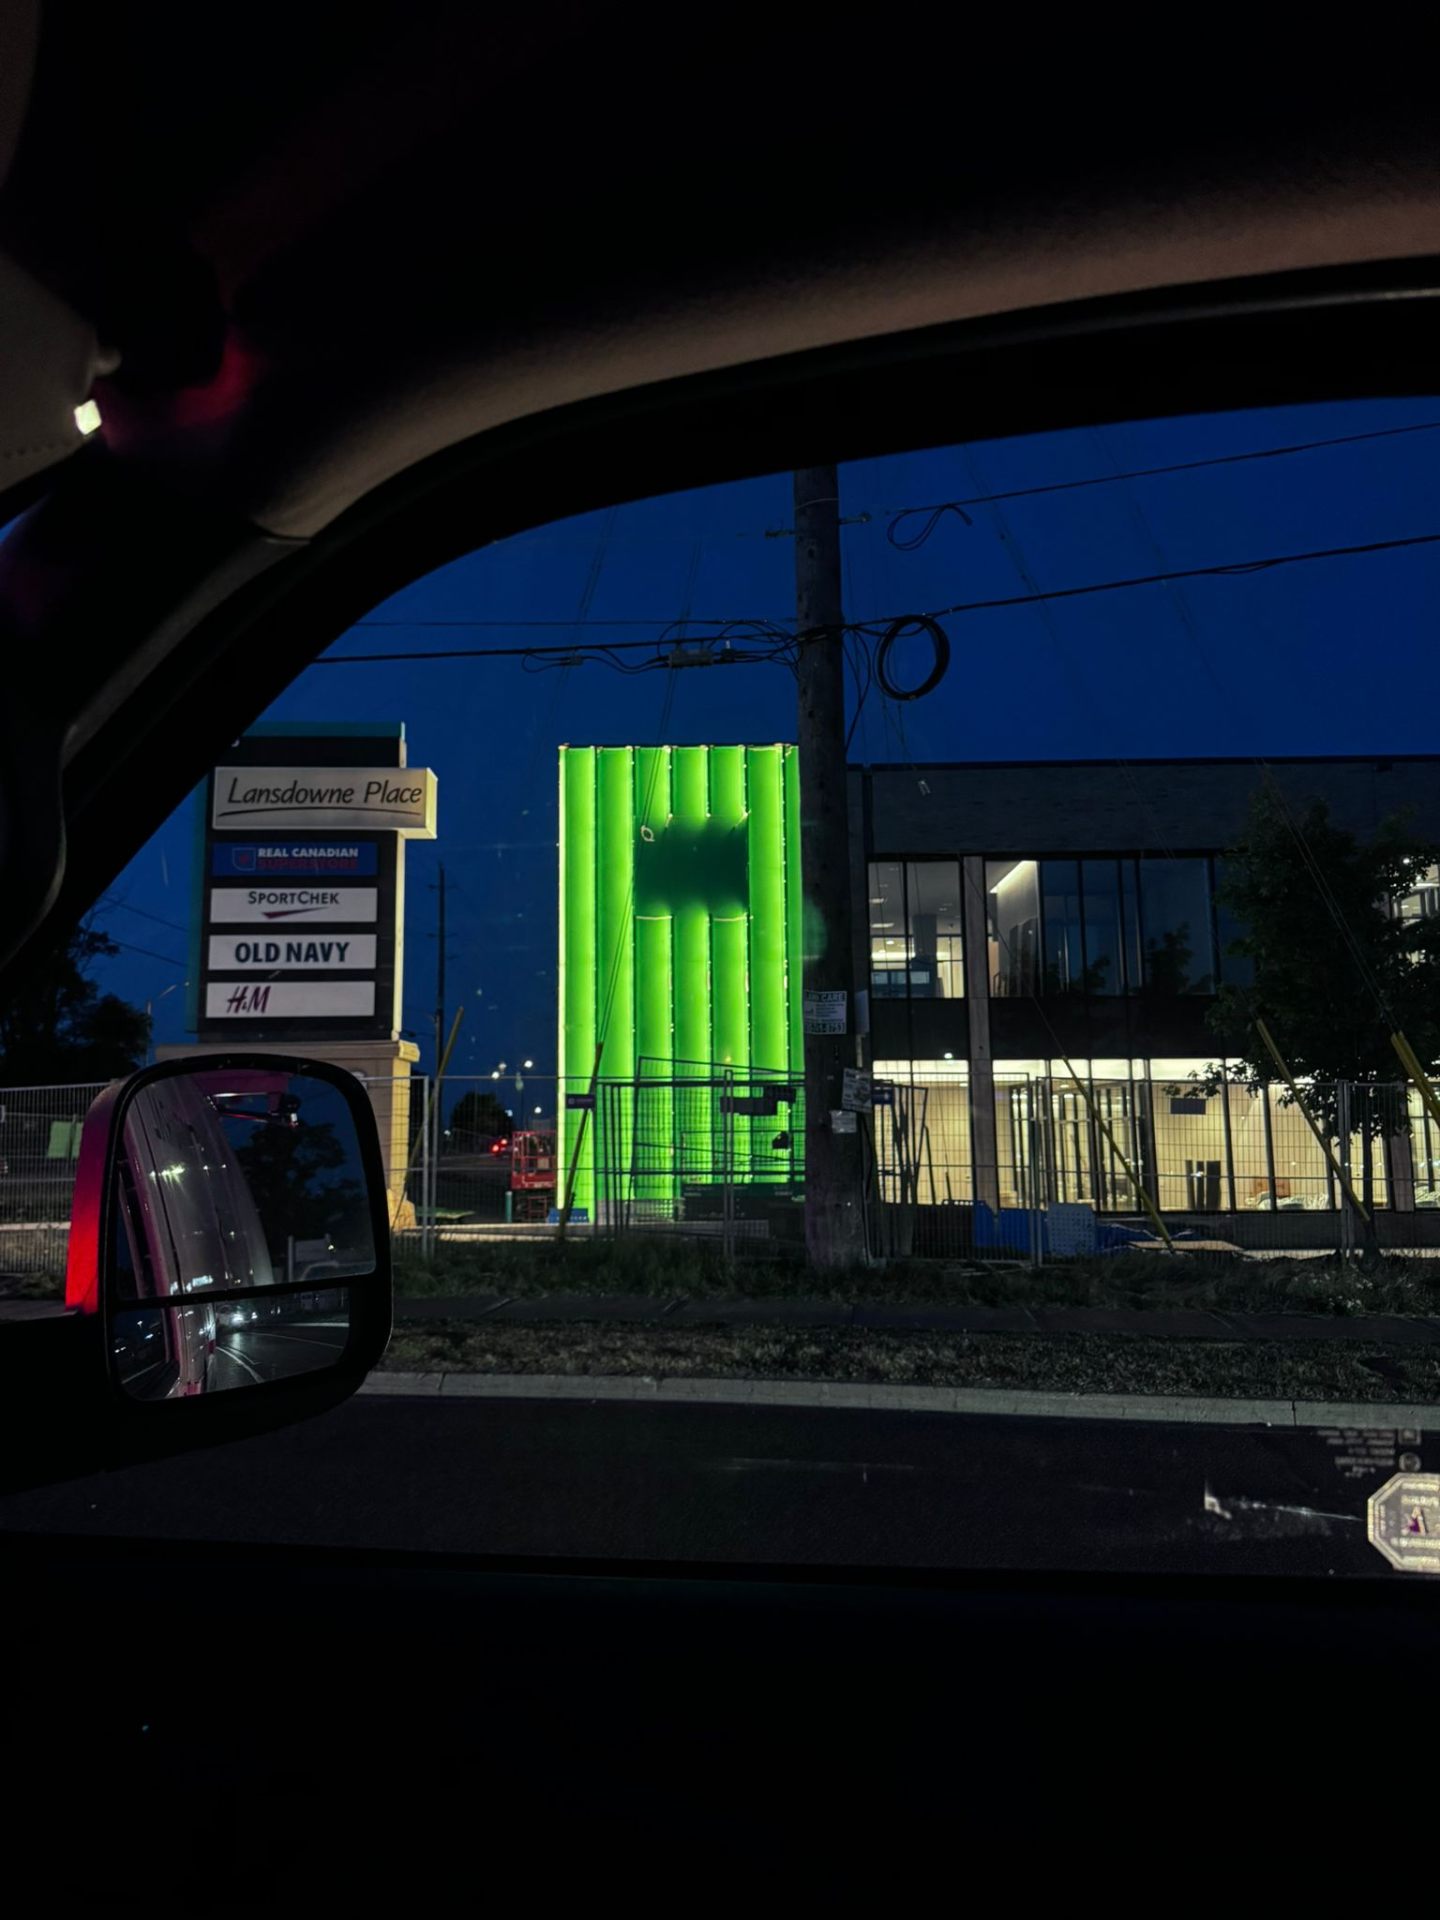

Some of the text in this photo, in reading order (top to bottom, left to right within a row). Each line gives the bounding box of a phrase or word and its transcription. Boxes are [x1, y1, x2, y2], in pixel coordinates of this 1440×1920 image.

[228, 778, 423, 804] Lansdowne Place
[257, 847, 359, 858] REAL CANADIAN
[235, 942, 350, 963] OLD NAVY
[226, 986, 271, 1014] H&M
